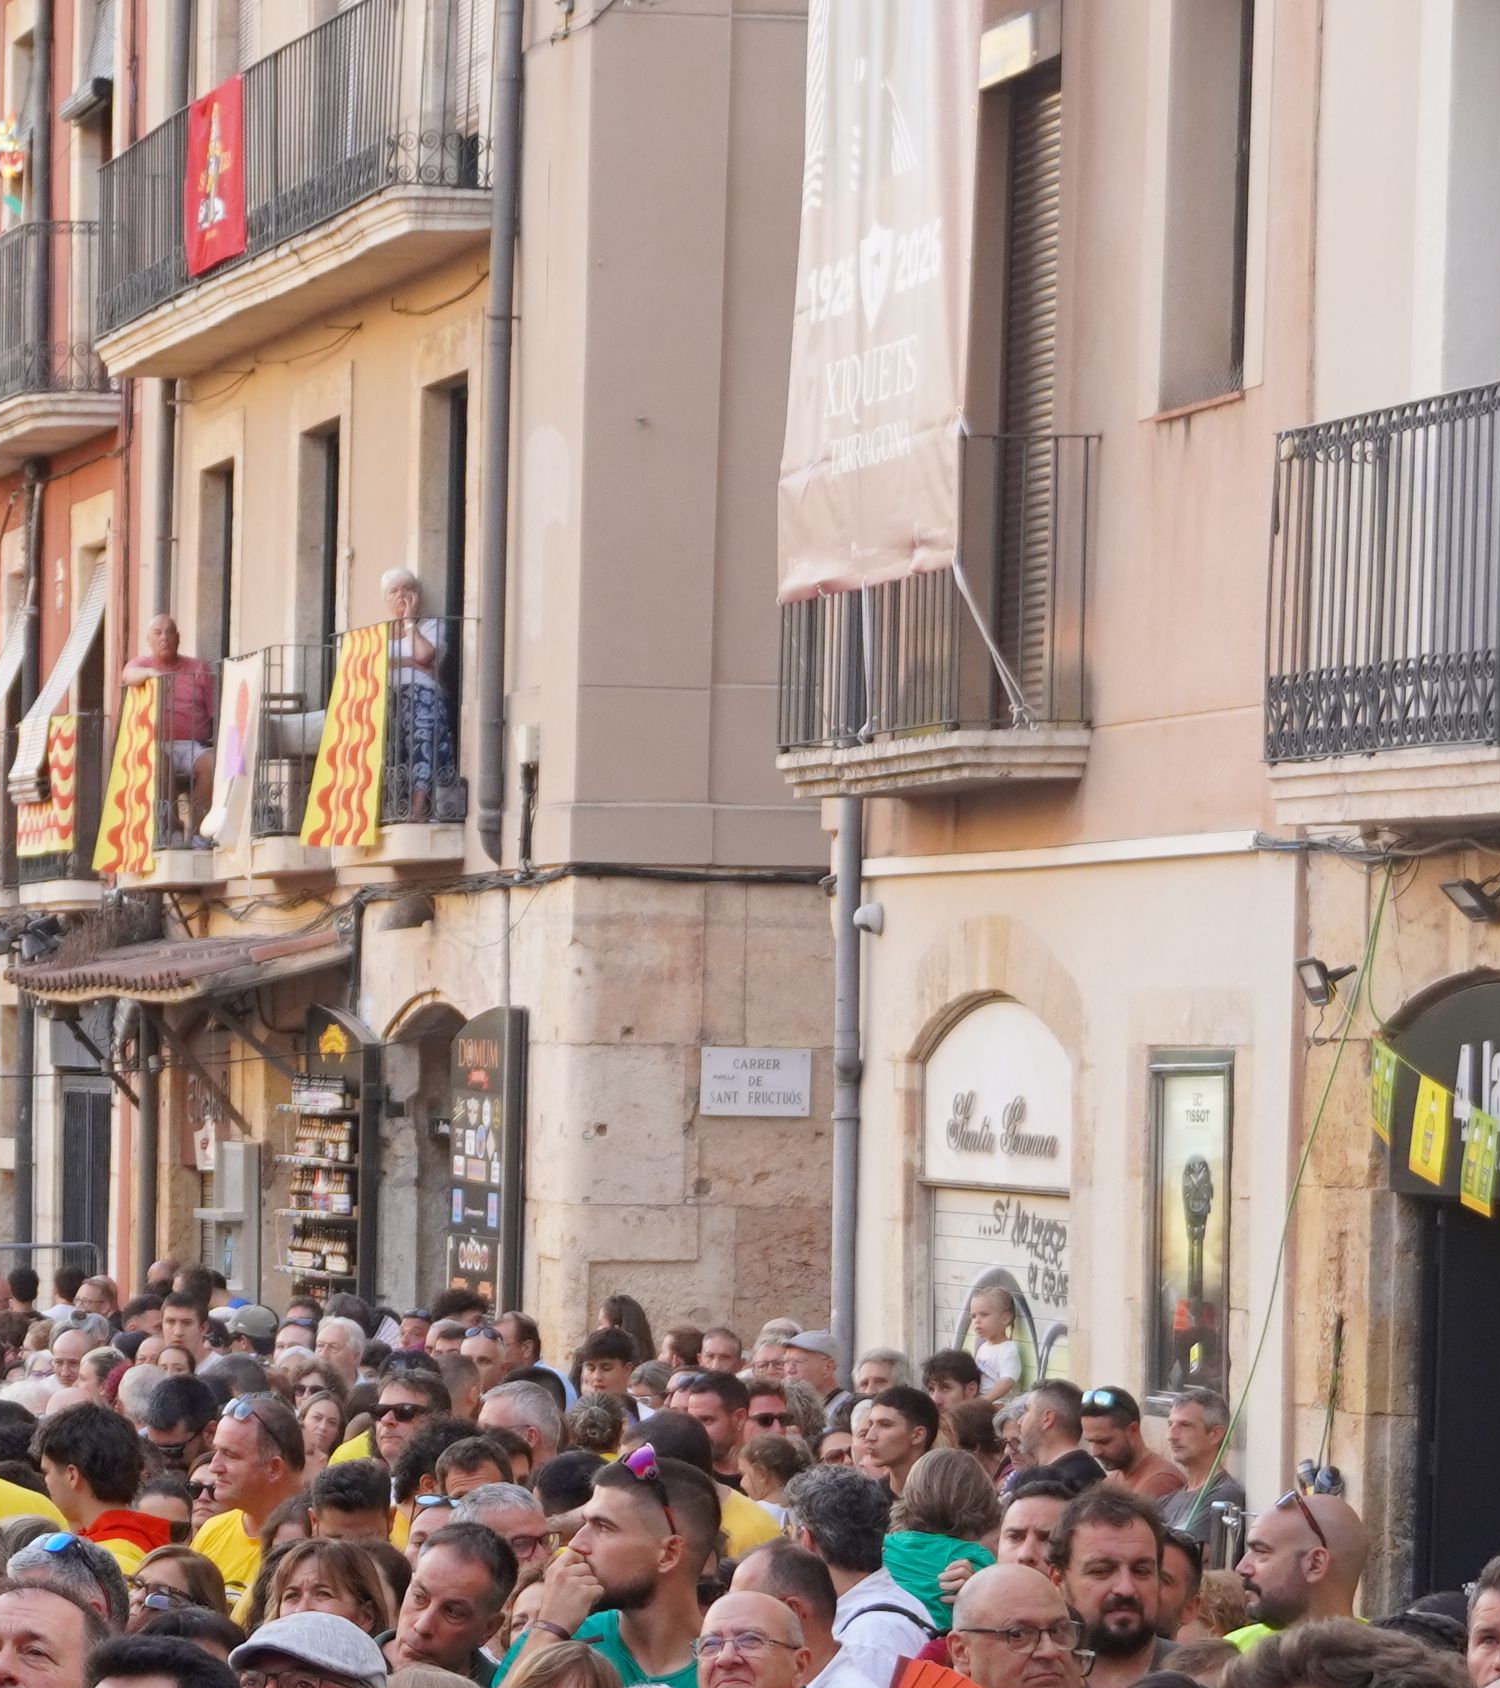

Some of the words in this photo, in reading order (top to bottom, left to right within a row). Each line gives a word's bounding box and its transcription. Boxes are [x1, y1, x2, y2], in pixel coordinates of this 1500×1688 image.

[894, 218, 943, 294] 2026
[823, 334, 918, 425] XIQUETS
[829, 419, 913, 477] TARRAGONA
[732, 1058, 781, 1071] CARRER
[748, 1075, 763, 1087] DE
[710, 1090, 739, 1105] SANT
[748, 1089, 803, 1105] FRUCTUÓS
[1185, 1109, 1210, 1122] TISSOT
